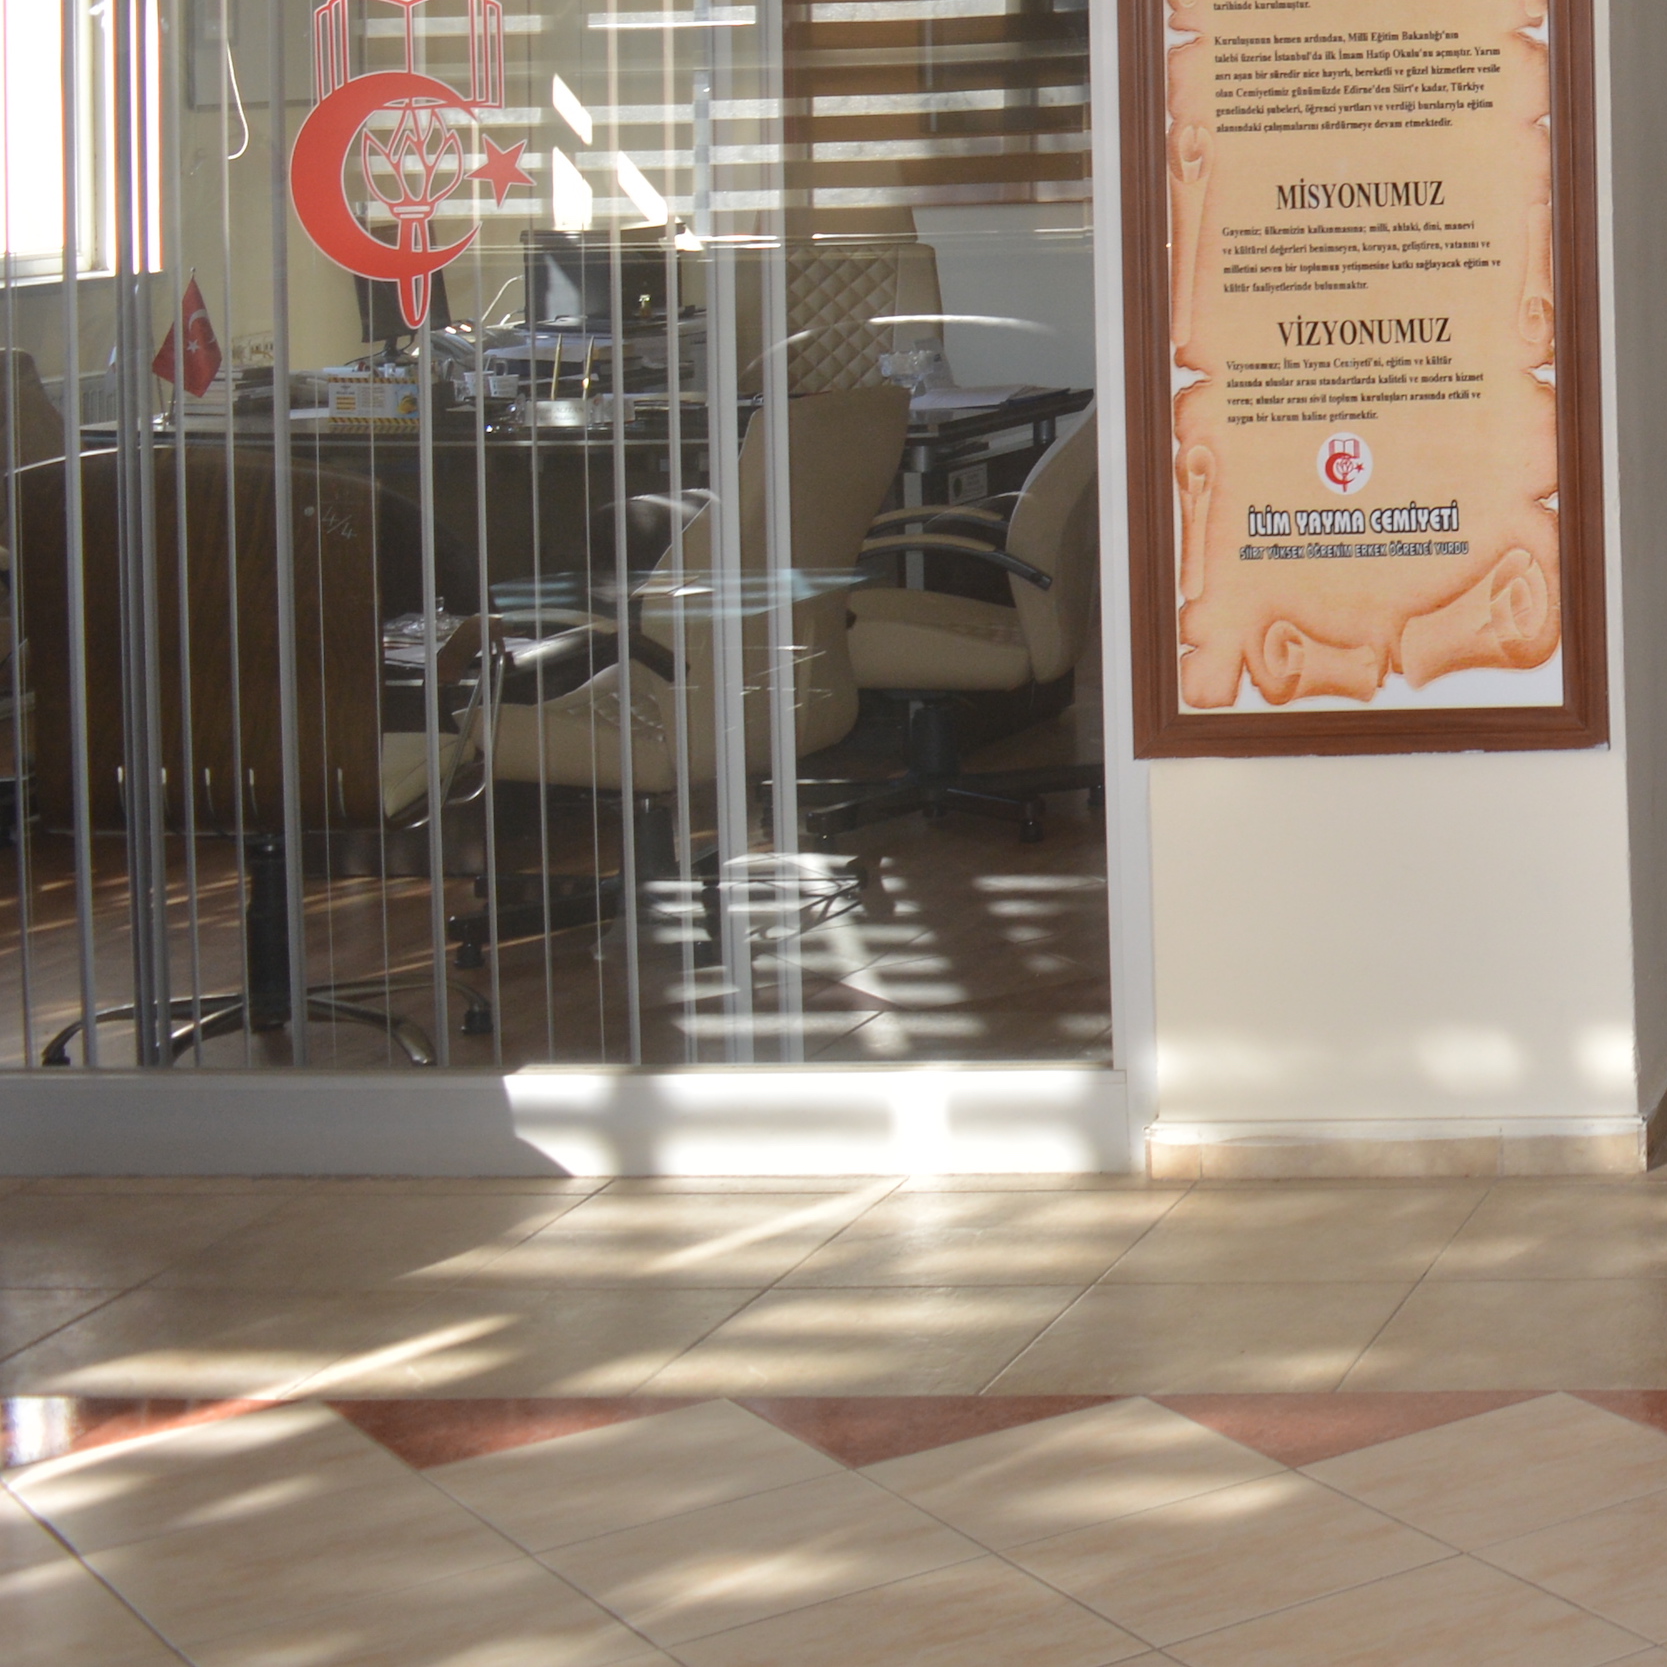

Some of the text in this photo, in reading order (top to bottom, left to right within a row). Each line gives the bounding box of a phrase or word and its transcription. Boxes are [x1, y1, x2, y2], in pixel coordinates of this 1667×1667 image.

[1371, 31, 1399, 43] Eğitim
[1276, 178, 1445, 210] MİSYONUMUZ
[1277, 315, 1451, 347] VİZYONUMUZ
[1249, 500, 1459, 536] İLİM YAYMA CEMİYETİ
[1355, 543, 1387, 557] ERKEK
[1435, 540, 1469, 555] YURDU
